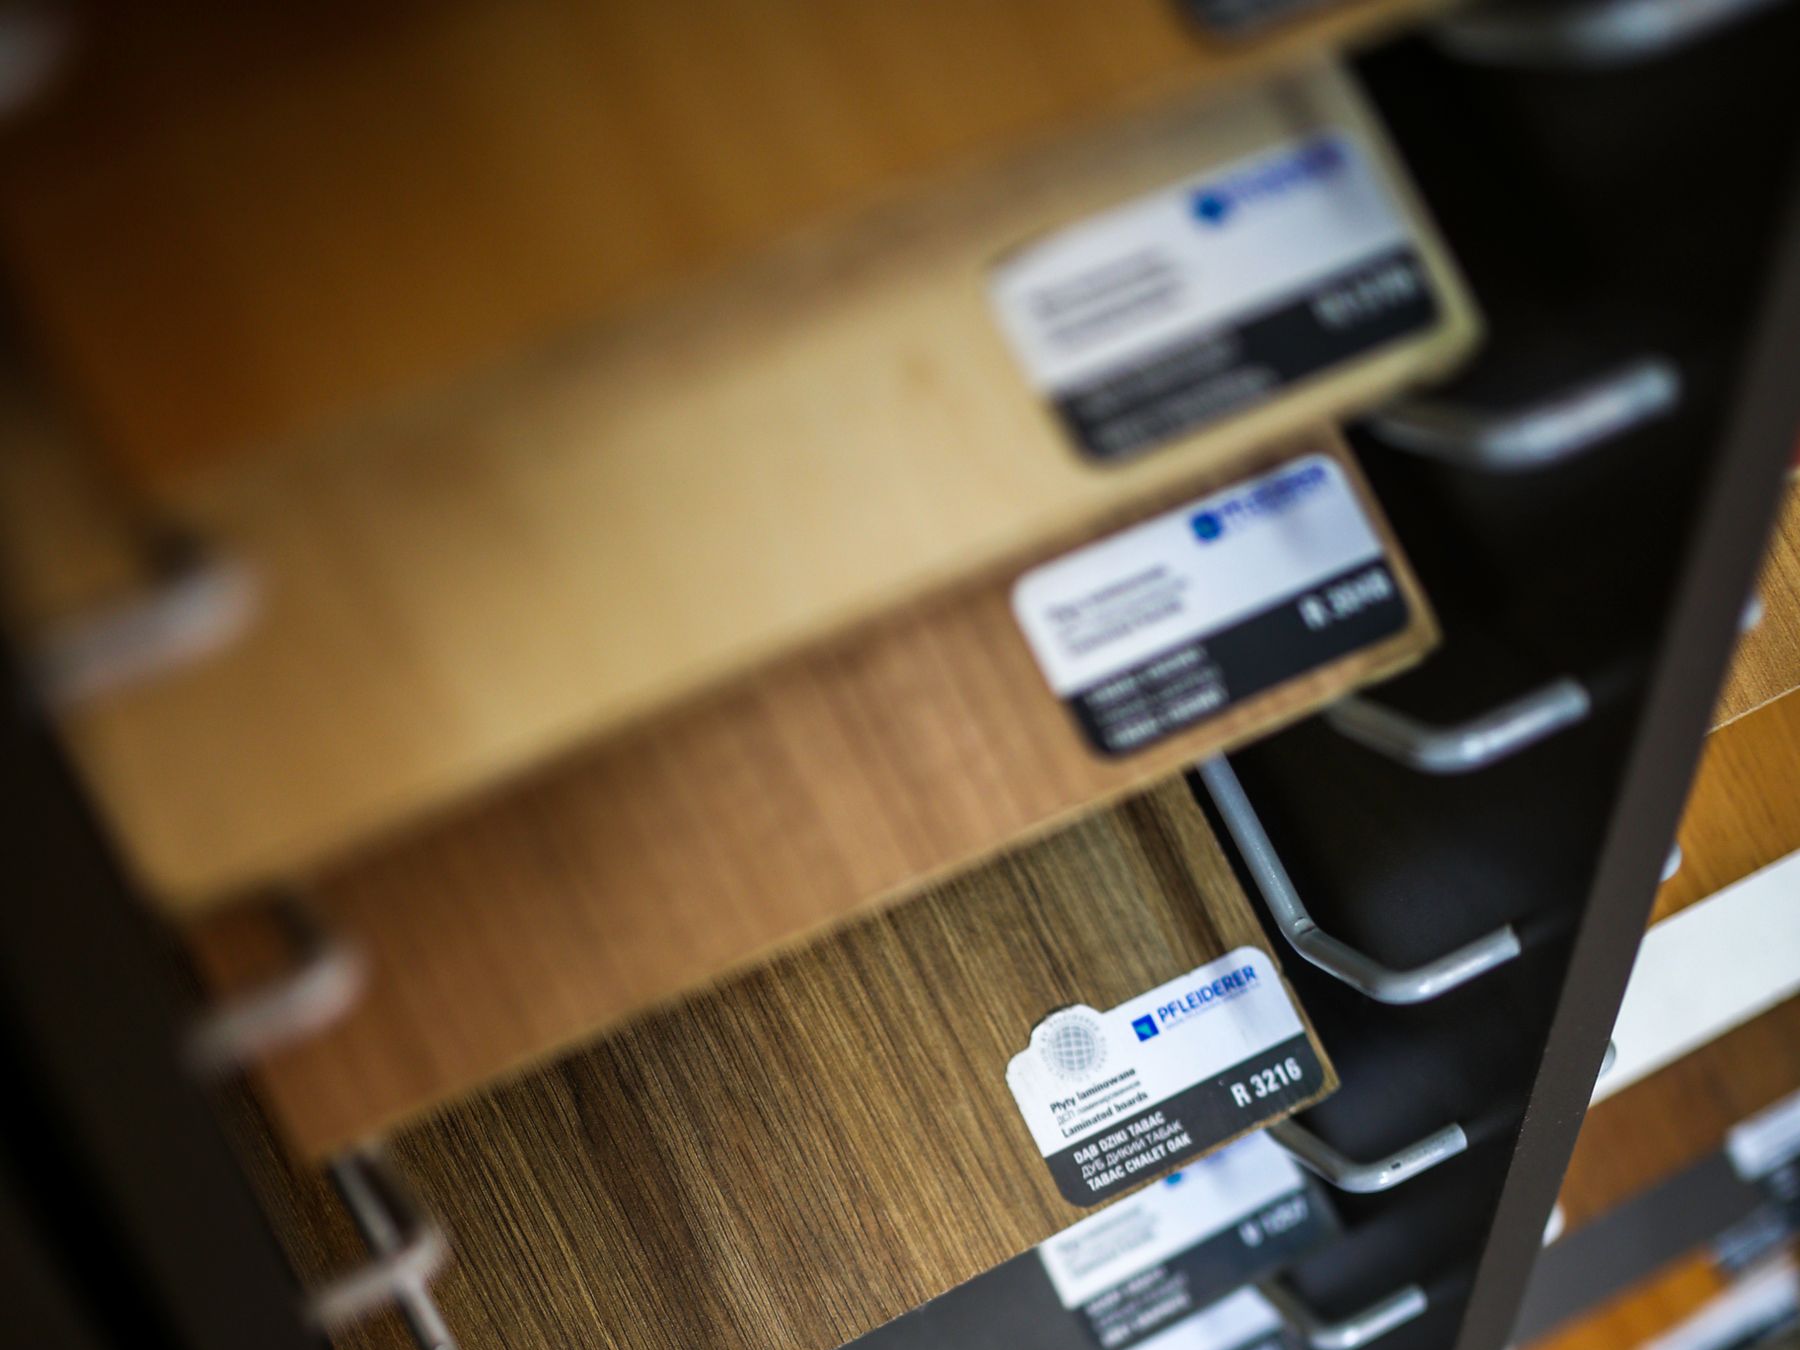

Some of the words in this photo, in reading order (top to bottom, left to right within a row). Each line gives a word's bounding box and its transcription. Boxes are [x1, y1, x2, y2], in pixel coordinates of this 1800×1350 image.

[1156, 964, 1258, 1023] PFLEIDERER
[1050, 1094, 1078, 1114] Płyty
[1230, 1082, 1252, 1108] R
[1250, 1057, 1303, 1098] 3216
[1061, 1107, 1113, 1139] Laminated
[1114, 1091, 1149, 1113] boards
[1073, 1142, 1100, 1165] DĄB
[1098, 1129, 1130, 1152] DZIKI
[1127, 1110, 1166, 1137] TABAC
[1087, 1165, 1127, 1192] TABAC
[1124, 1143, 1169, 1174] CHALET
[1165, 1131, 1193, 1152] OAK
